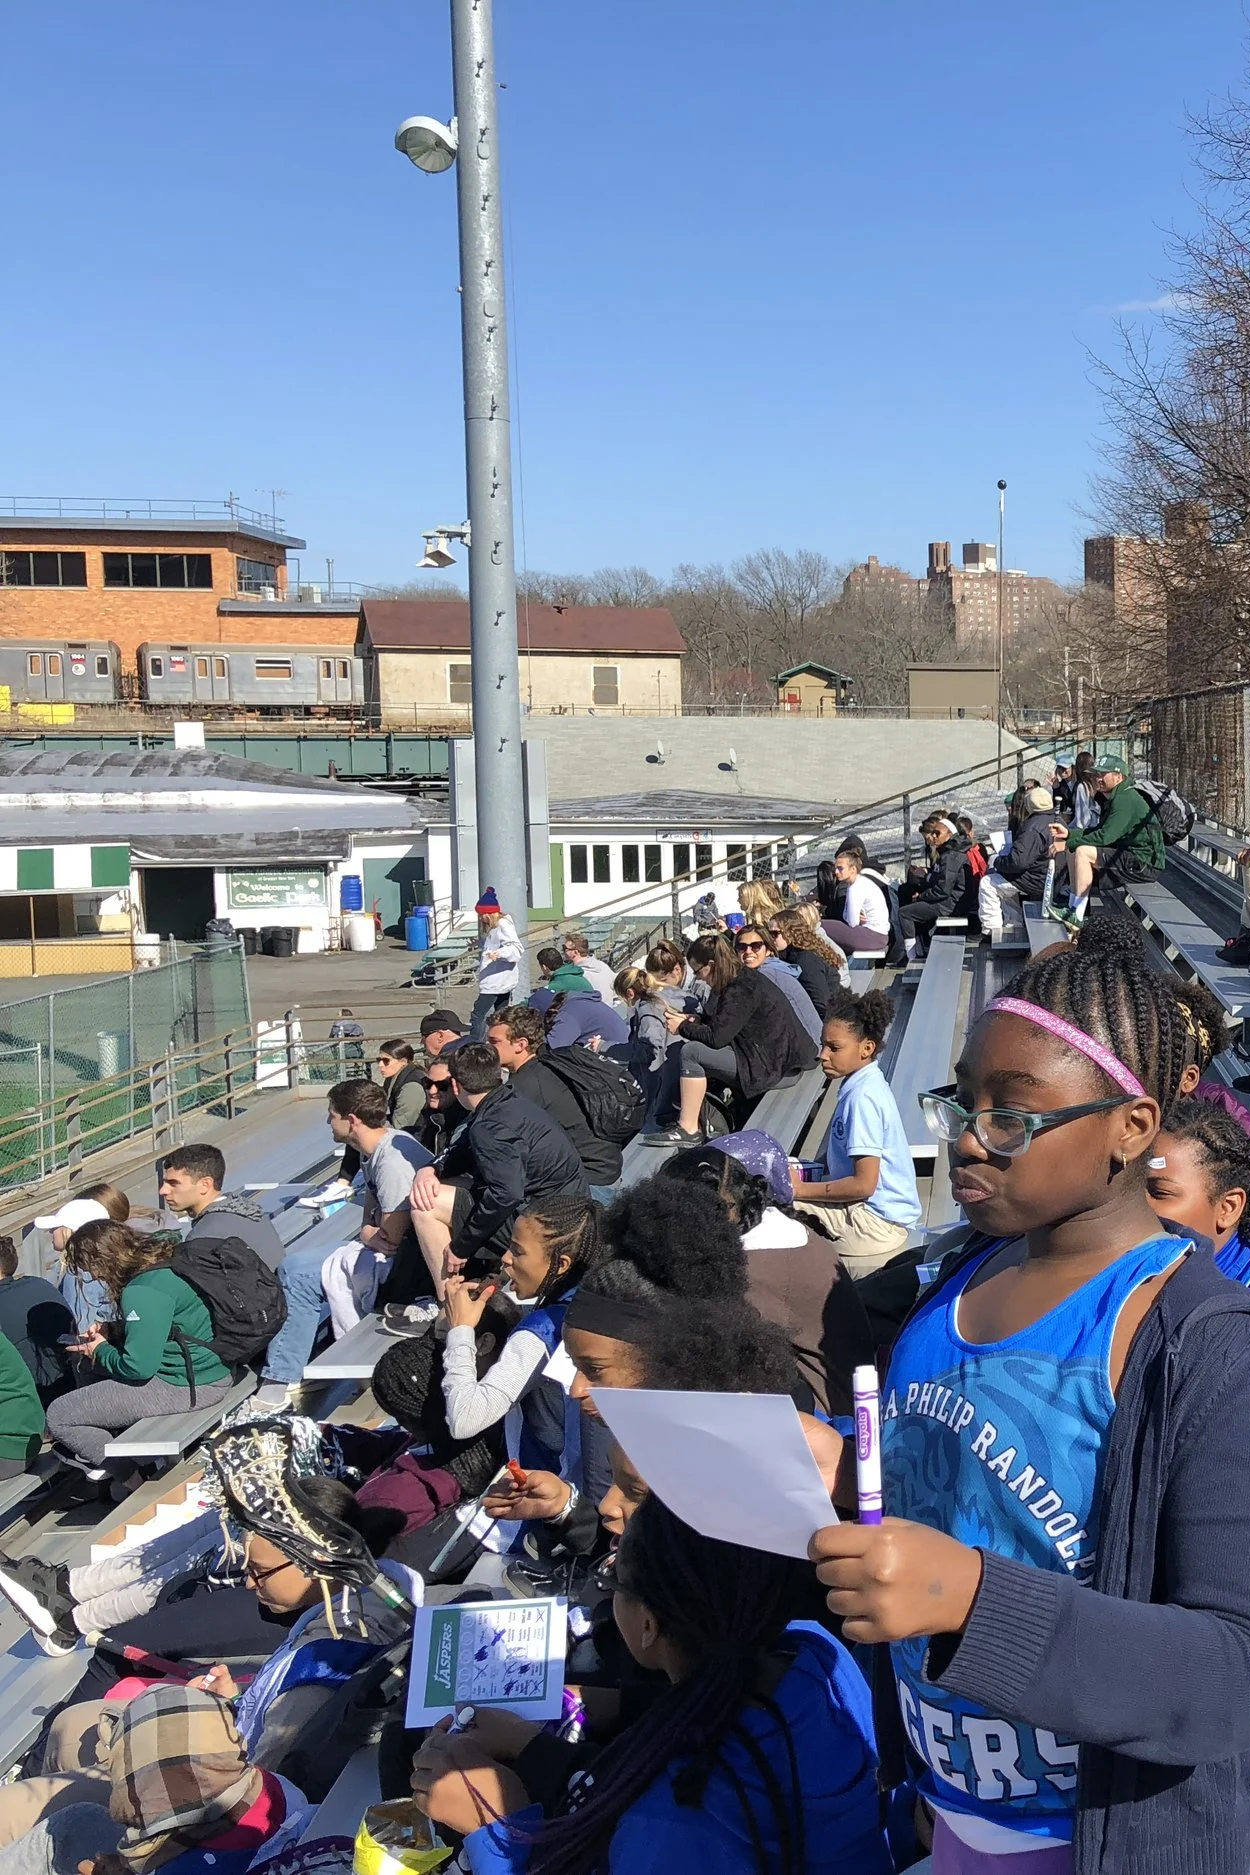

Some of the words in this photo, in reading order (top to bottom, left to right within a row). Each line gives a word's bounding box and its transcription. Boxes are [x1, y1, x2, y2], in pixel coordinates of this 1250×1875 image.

[858, 1411, 870, 1457] Crayola
[904, 1381, 976, 1435] PHILIP
[434, 1621, 454, 1689] JASPERS
